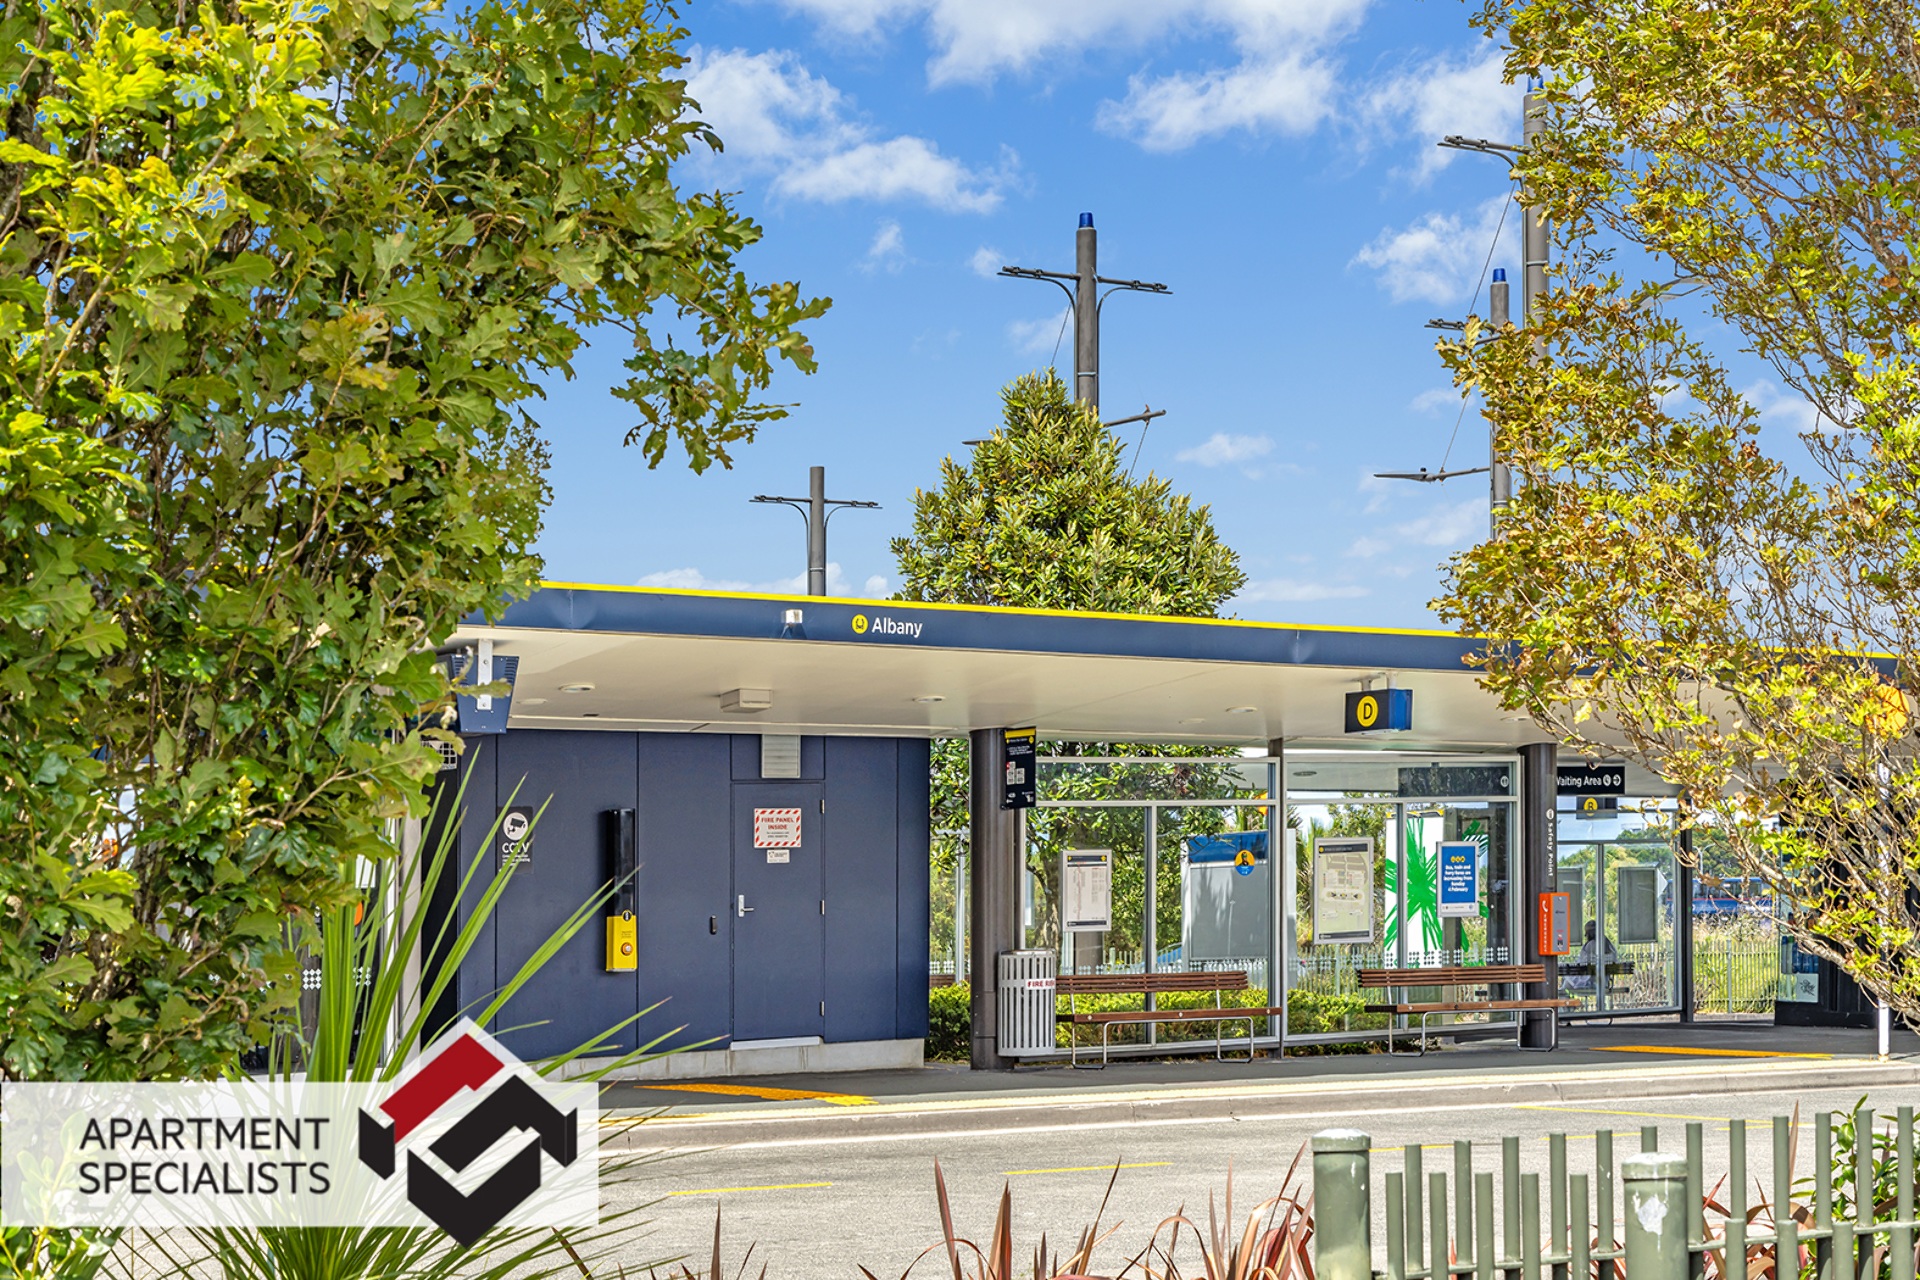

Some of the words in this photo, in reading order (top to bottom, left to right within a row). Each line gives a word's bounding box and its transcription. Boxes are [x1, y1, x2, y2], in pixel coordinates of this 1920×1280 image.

[872, 617, 923, 638] Albany
[1363, 703, 1373, 719] D
[1583, 775, 1602, 786] Area
